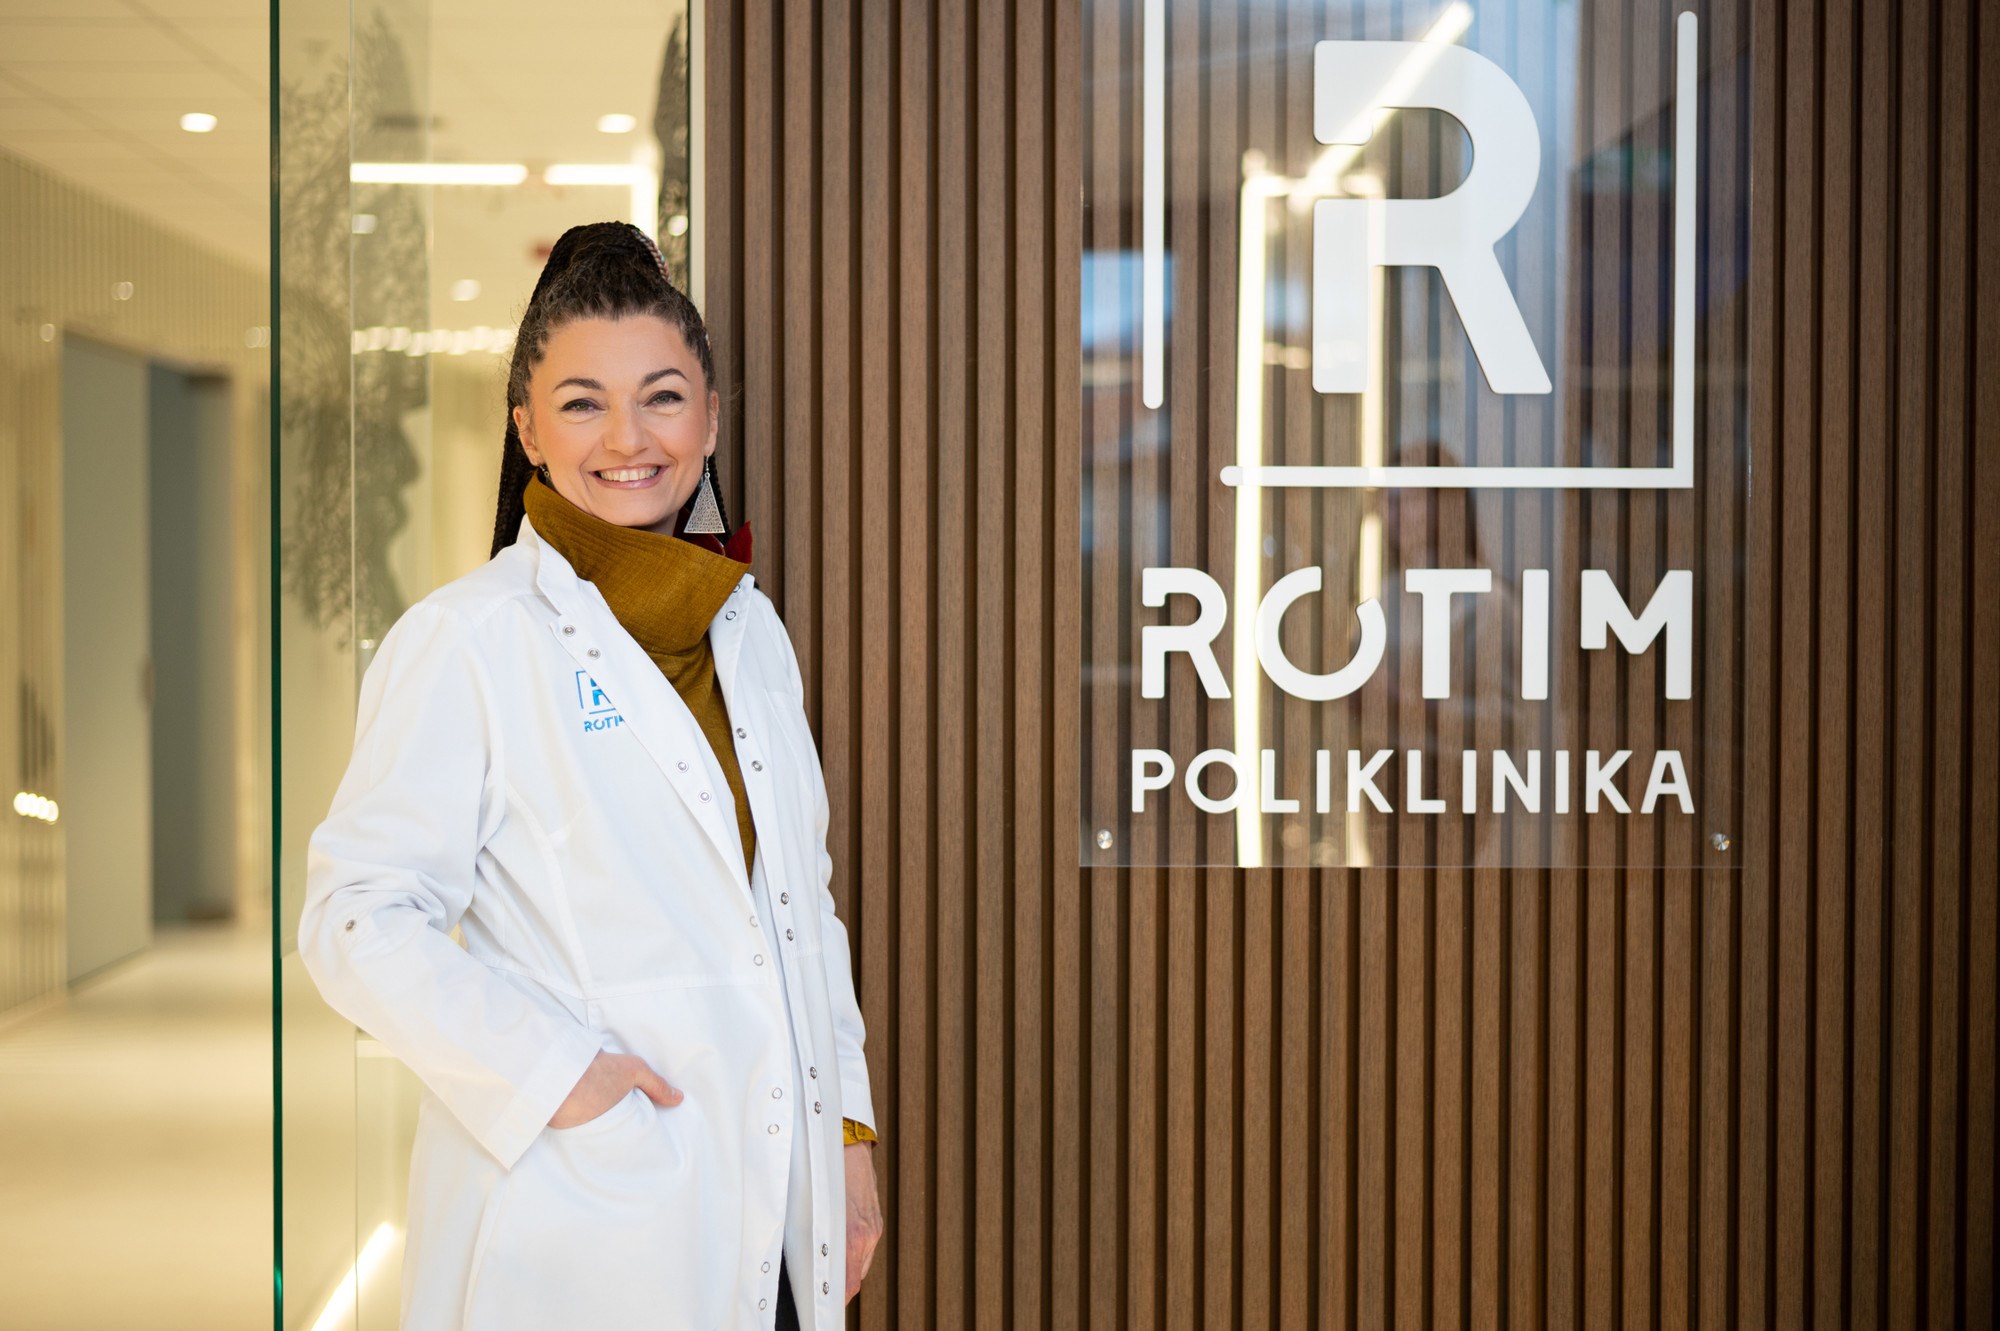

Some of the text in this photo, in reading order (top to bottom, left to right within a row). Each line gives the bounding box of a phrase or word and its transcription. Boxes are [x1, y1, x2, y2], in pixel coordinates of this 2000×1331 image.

[1313, 40, 1552, 394] R
[1141, 566, 1694, 701] ROTIM
[1131, 749, 1695, 814] POLIKLINIKA
